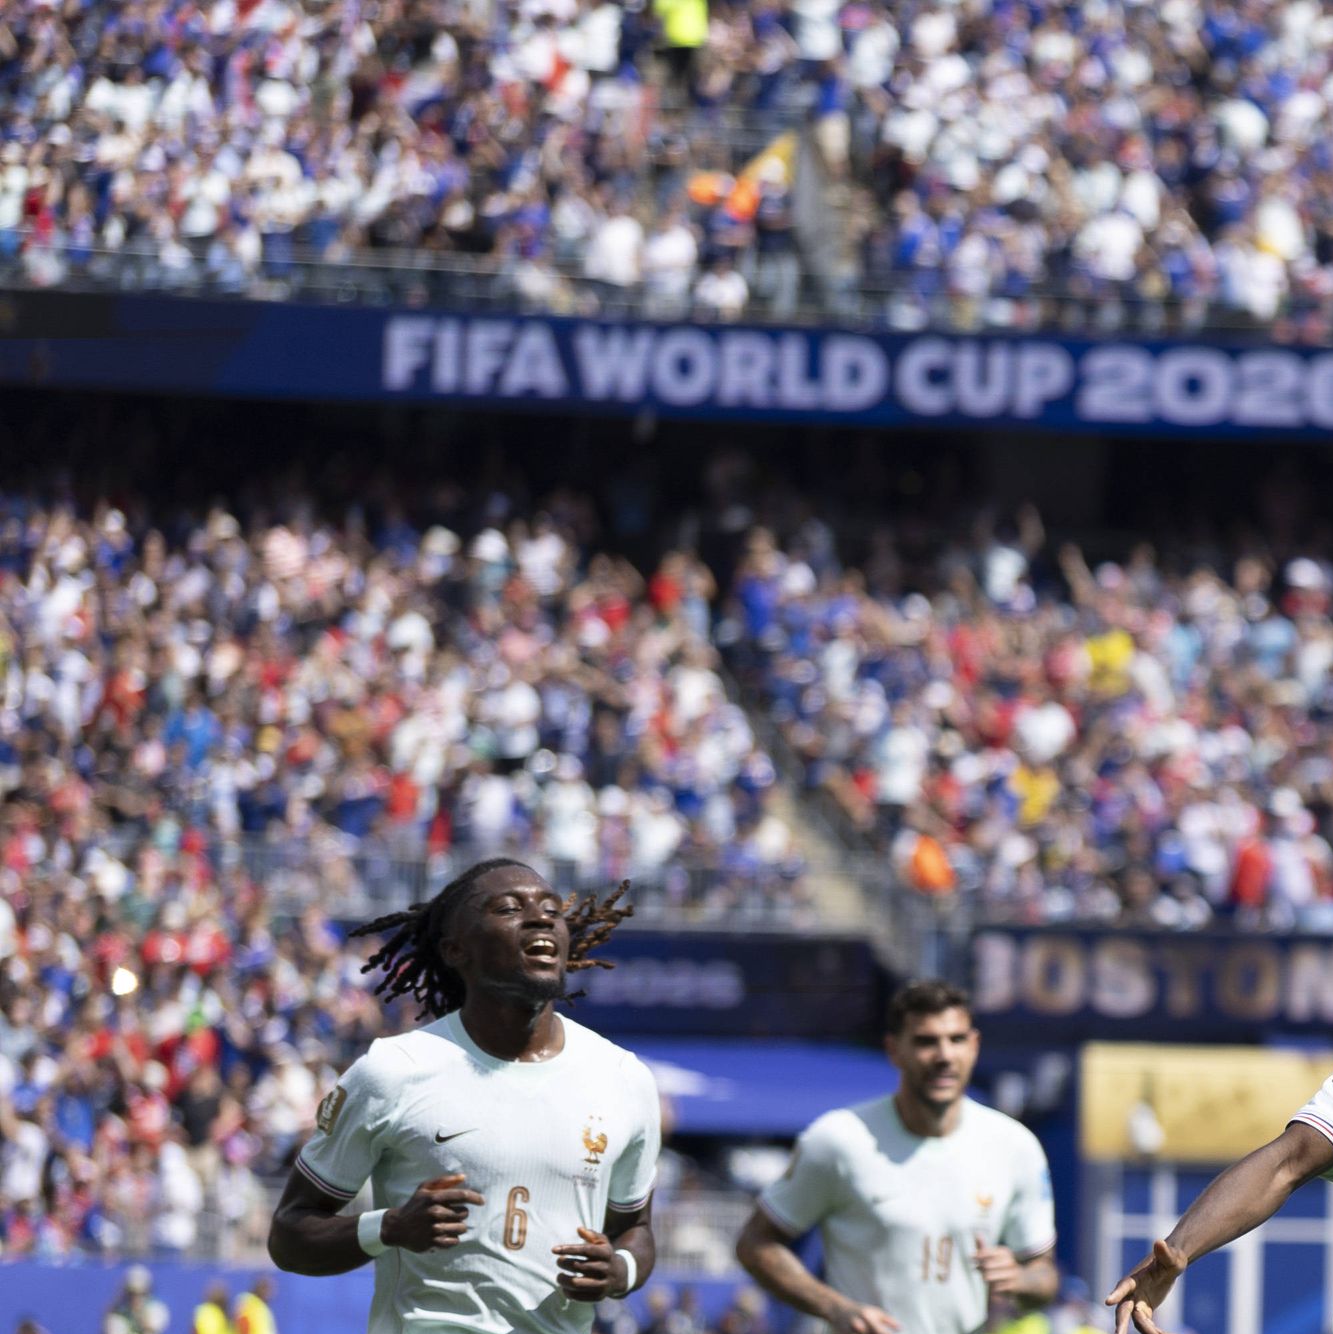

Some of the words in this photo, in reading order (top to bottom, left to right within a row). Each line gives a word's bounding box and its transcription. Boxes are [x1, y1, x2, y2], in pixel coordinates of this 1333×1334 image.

[382, 317, 568, 397] FIFA
[573, 326, 889, 411] WORLD
[895, 336, 1073, 418] CUP
[503, 1185, 530, 1251] 6
